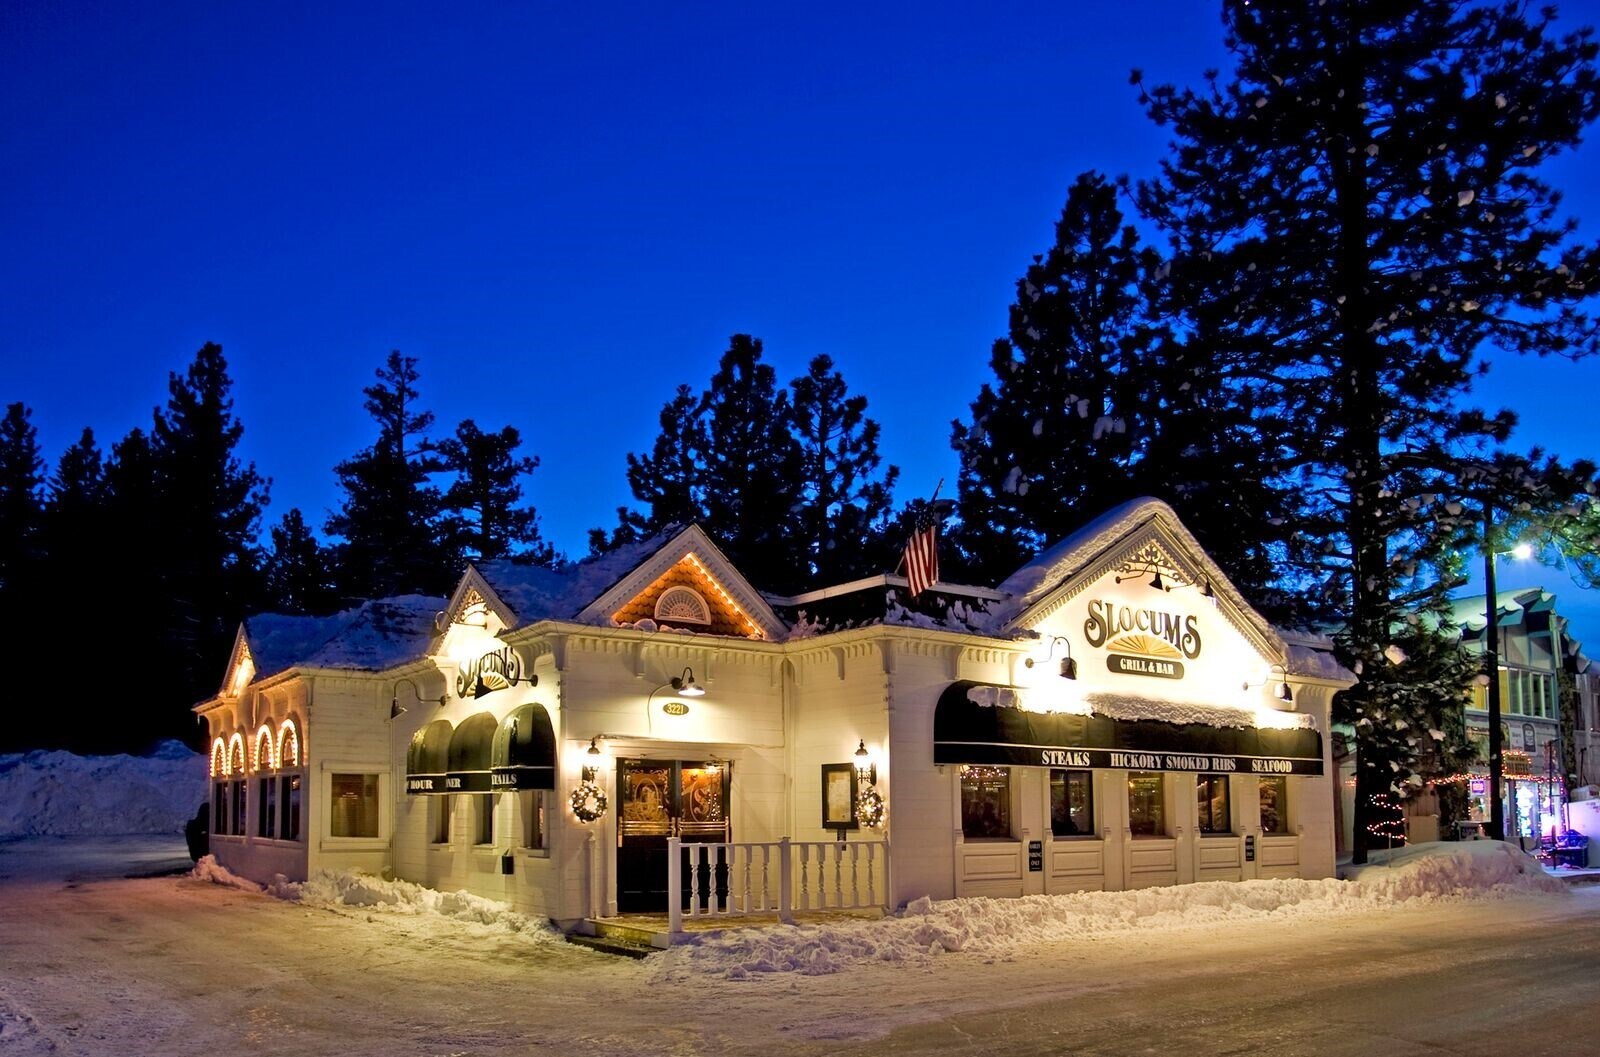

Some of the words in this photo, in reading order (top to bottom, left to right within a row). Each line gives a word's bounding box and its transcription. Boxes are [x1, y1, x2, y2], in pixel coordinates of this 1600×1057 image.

[1084, 599, 1202, 660] SLOCUMS
[1120, 658, 1148, 672] GRILL
[1148, 664, 1156, 673] &
[1156, 662, 1175, 675] BAR
[667, 703, 684, 715] 3221
[1041, 749, 1090, 767] STEAKS
[1110, 752, 1163, 769] HICKORY
[1166, 755, 1210, 770] SMOKED
[1212, 757, 1237, 771] RIBS
[1251, 759, 1293, 773] SEAFOOD
